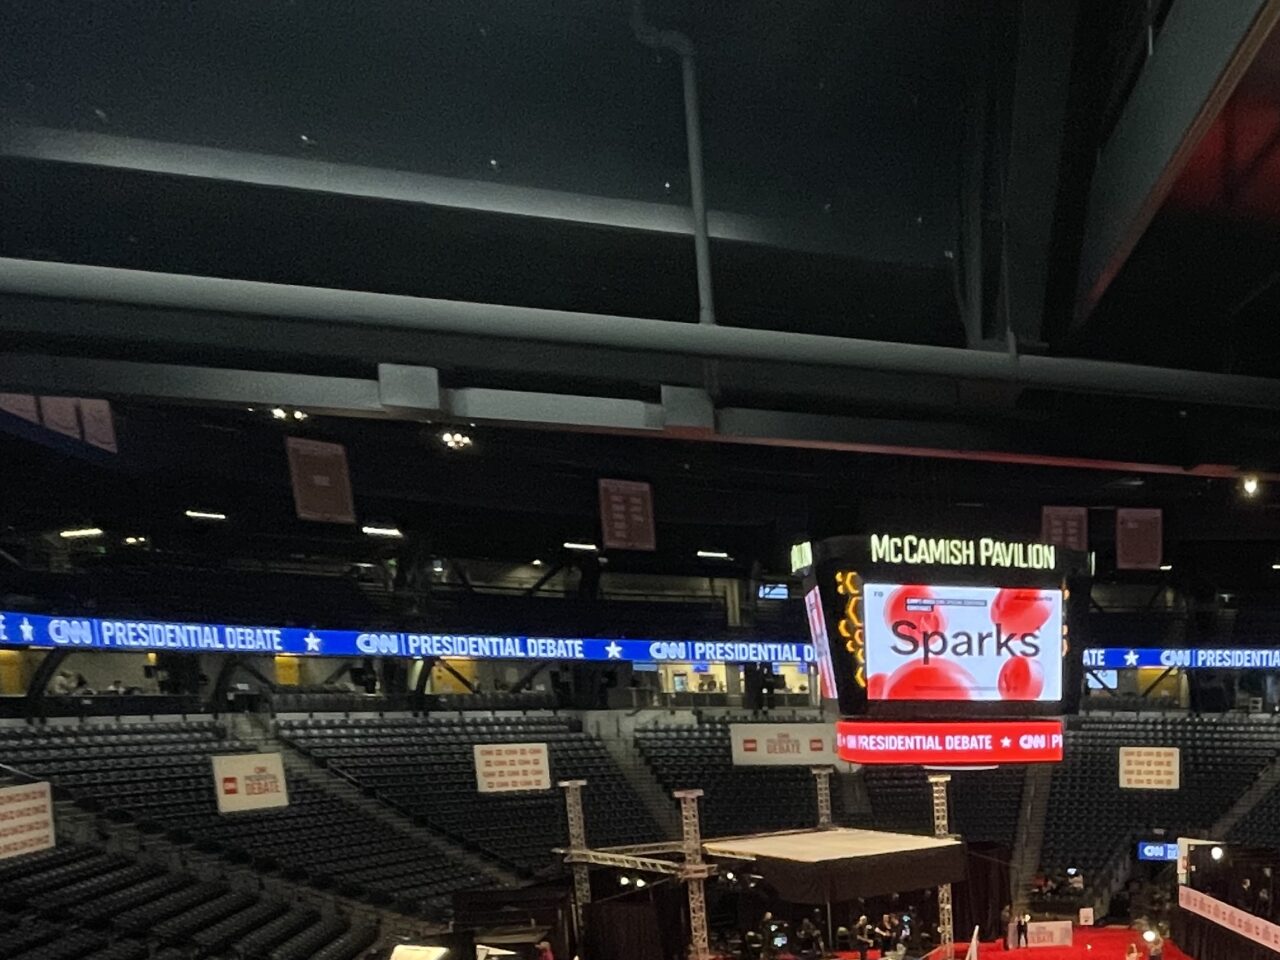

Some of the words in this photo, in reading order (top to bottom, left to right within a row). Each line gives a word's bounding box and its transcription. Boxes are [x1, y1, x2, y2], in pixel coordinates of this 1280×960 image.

[980, 538, 1056, 570] PAVILION
[48, 619, 93, 644] CNN
[102, 621, 224, 650] PRESIDENTIAL
[225, 627, 282, 650] DEBATE
[890, 620, 1041, 665] Sparks
[356, 634, 400, 654] CNN
[408, 635, 525, 657] PRESIDENTIAL
[527, 638, 584, 658] DEBATE
[649, 643, 686, 660] CNN
[695, 644, 801, 662] PRESIDENTIAL
[1160, 650, 1191, 667] CNN
[945, 734, 993, 750] DEBATE
[1019, 734, 1045, 749] CNN
